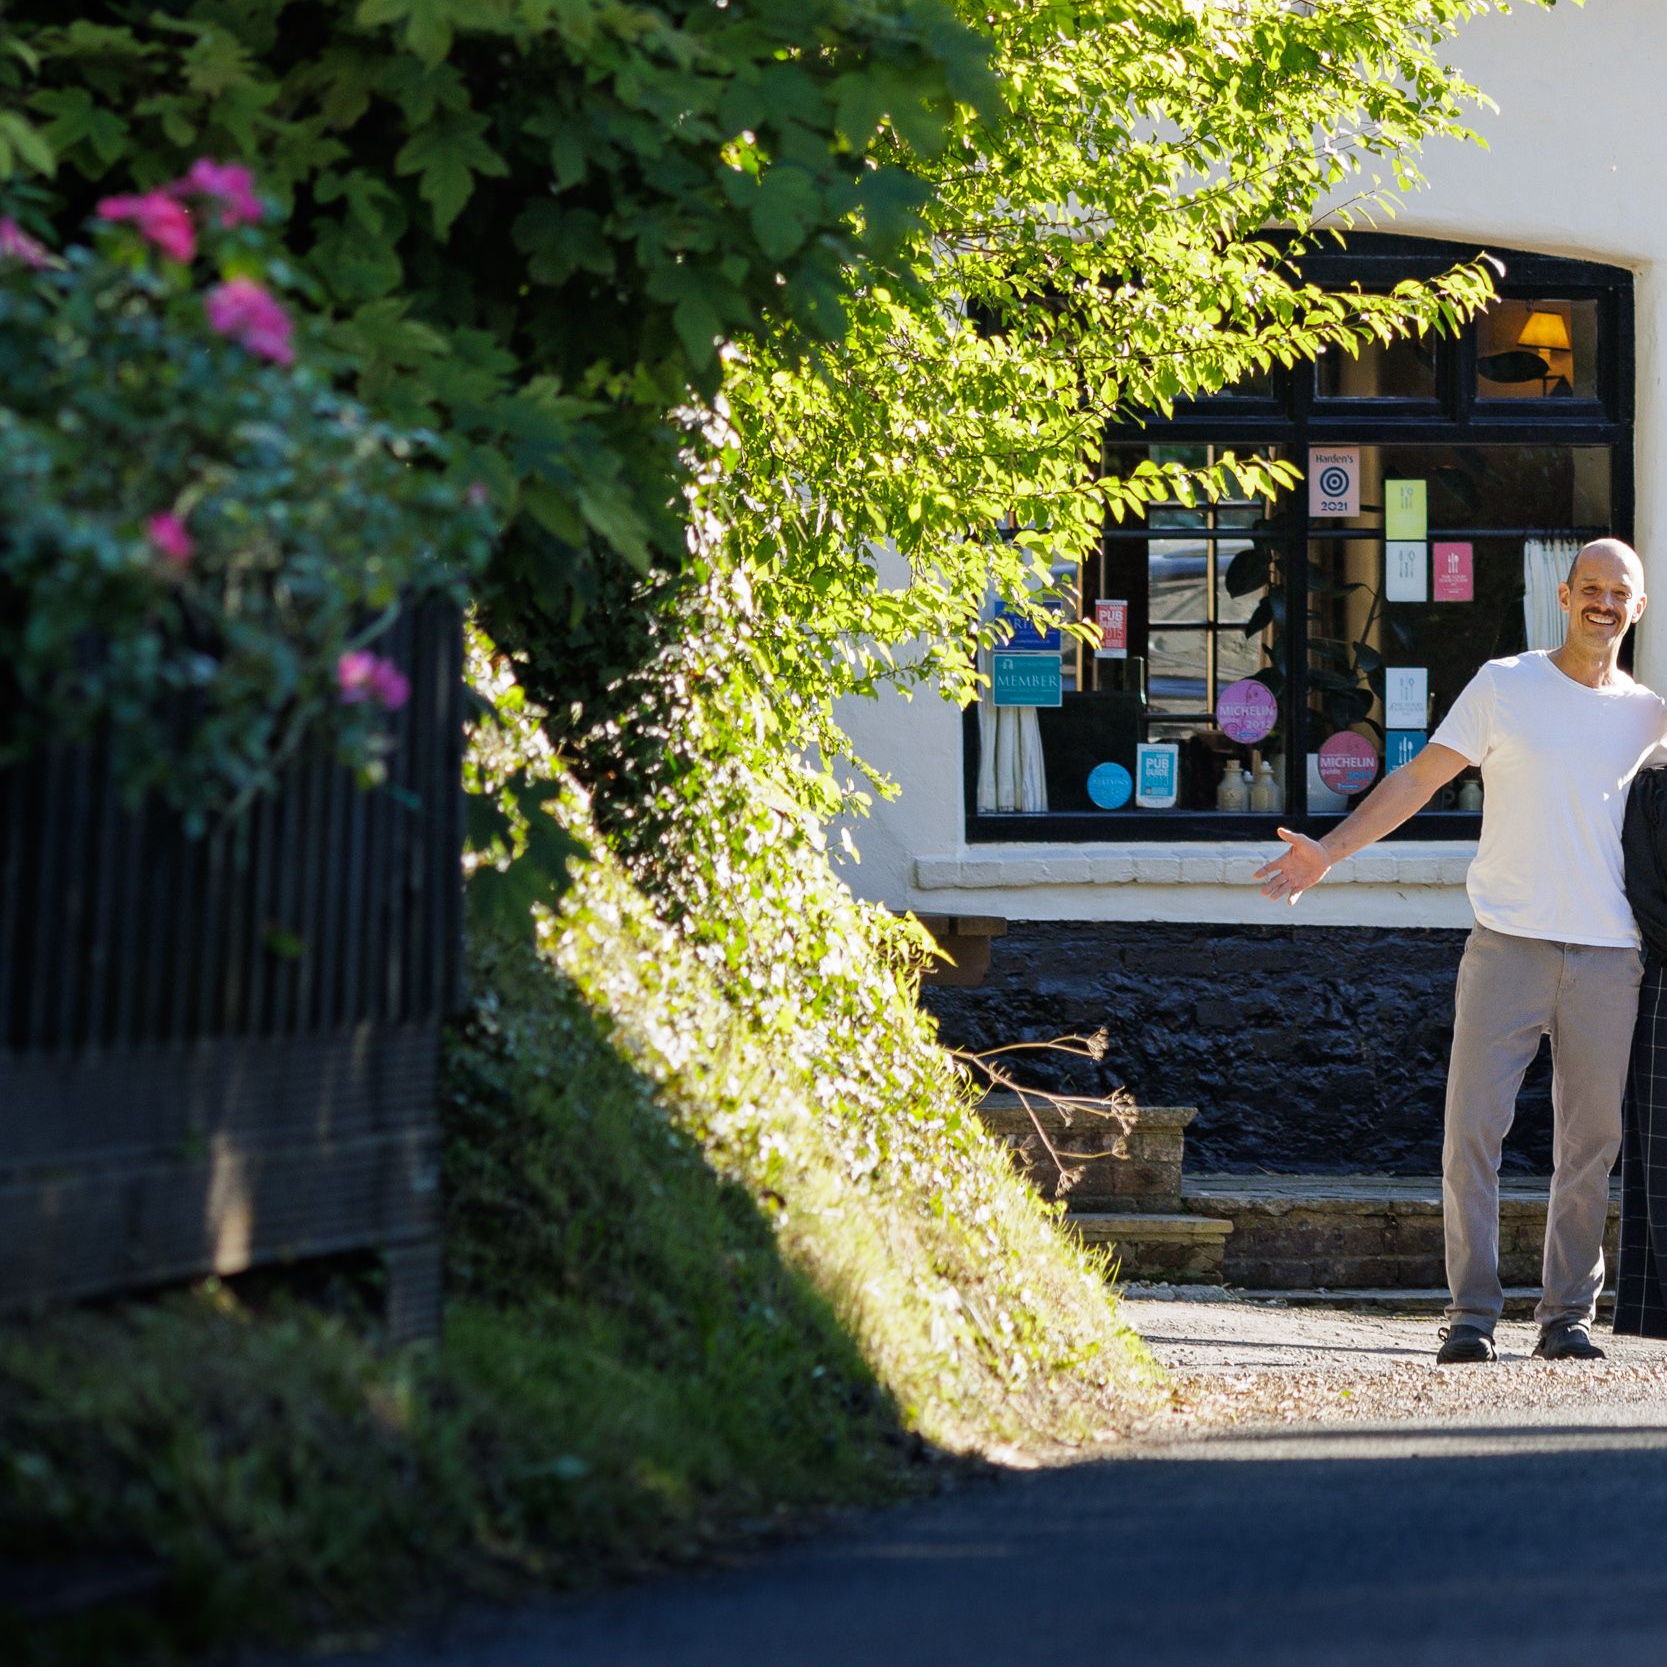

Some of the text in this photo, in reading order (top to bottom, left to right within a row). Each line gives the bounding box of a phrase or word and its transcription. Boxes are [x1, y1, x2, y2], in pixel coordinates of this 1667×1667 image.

[1315, 453, 1354, 464] Harden's
[1320, 501, 1348, 512] 2021
[1099, 609, 1124, 622] PUB
[997, 674, 1059, 687] MEMBER
[1219, 705, 1274, 717] MICHELIN
[1145, 757, 1170, 770] PUB
[1319, 757, 1375, 769] MICHELIN
